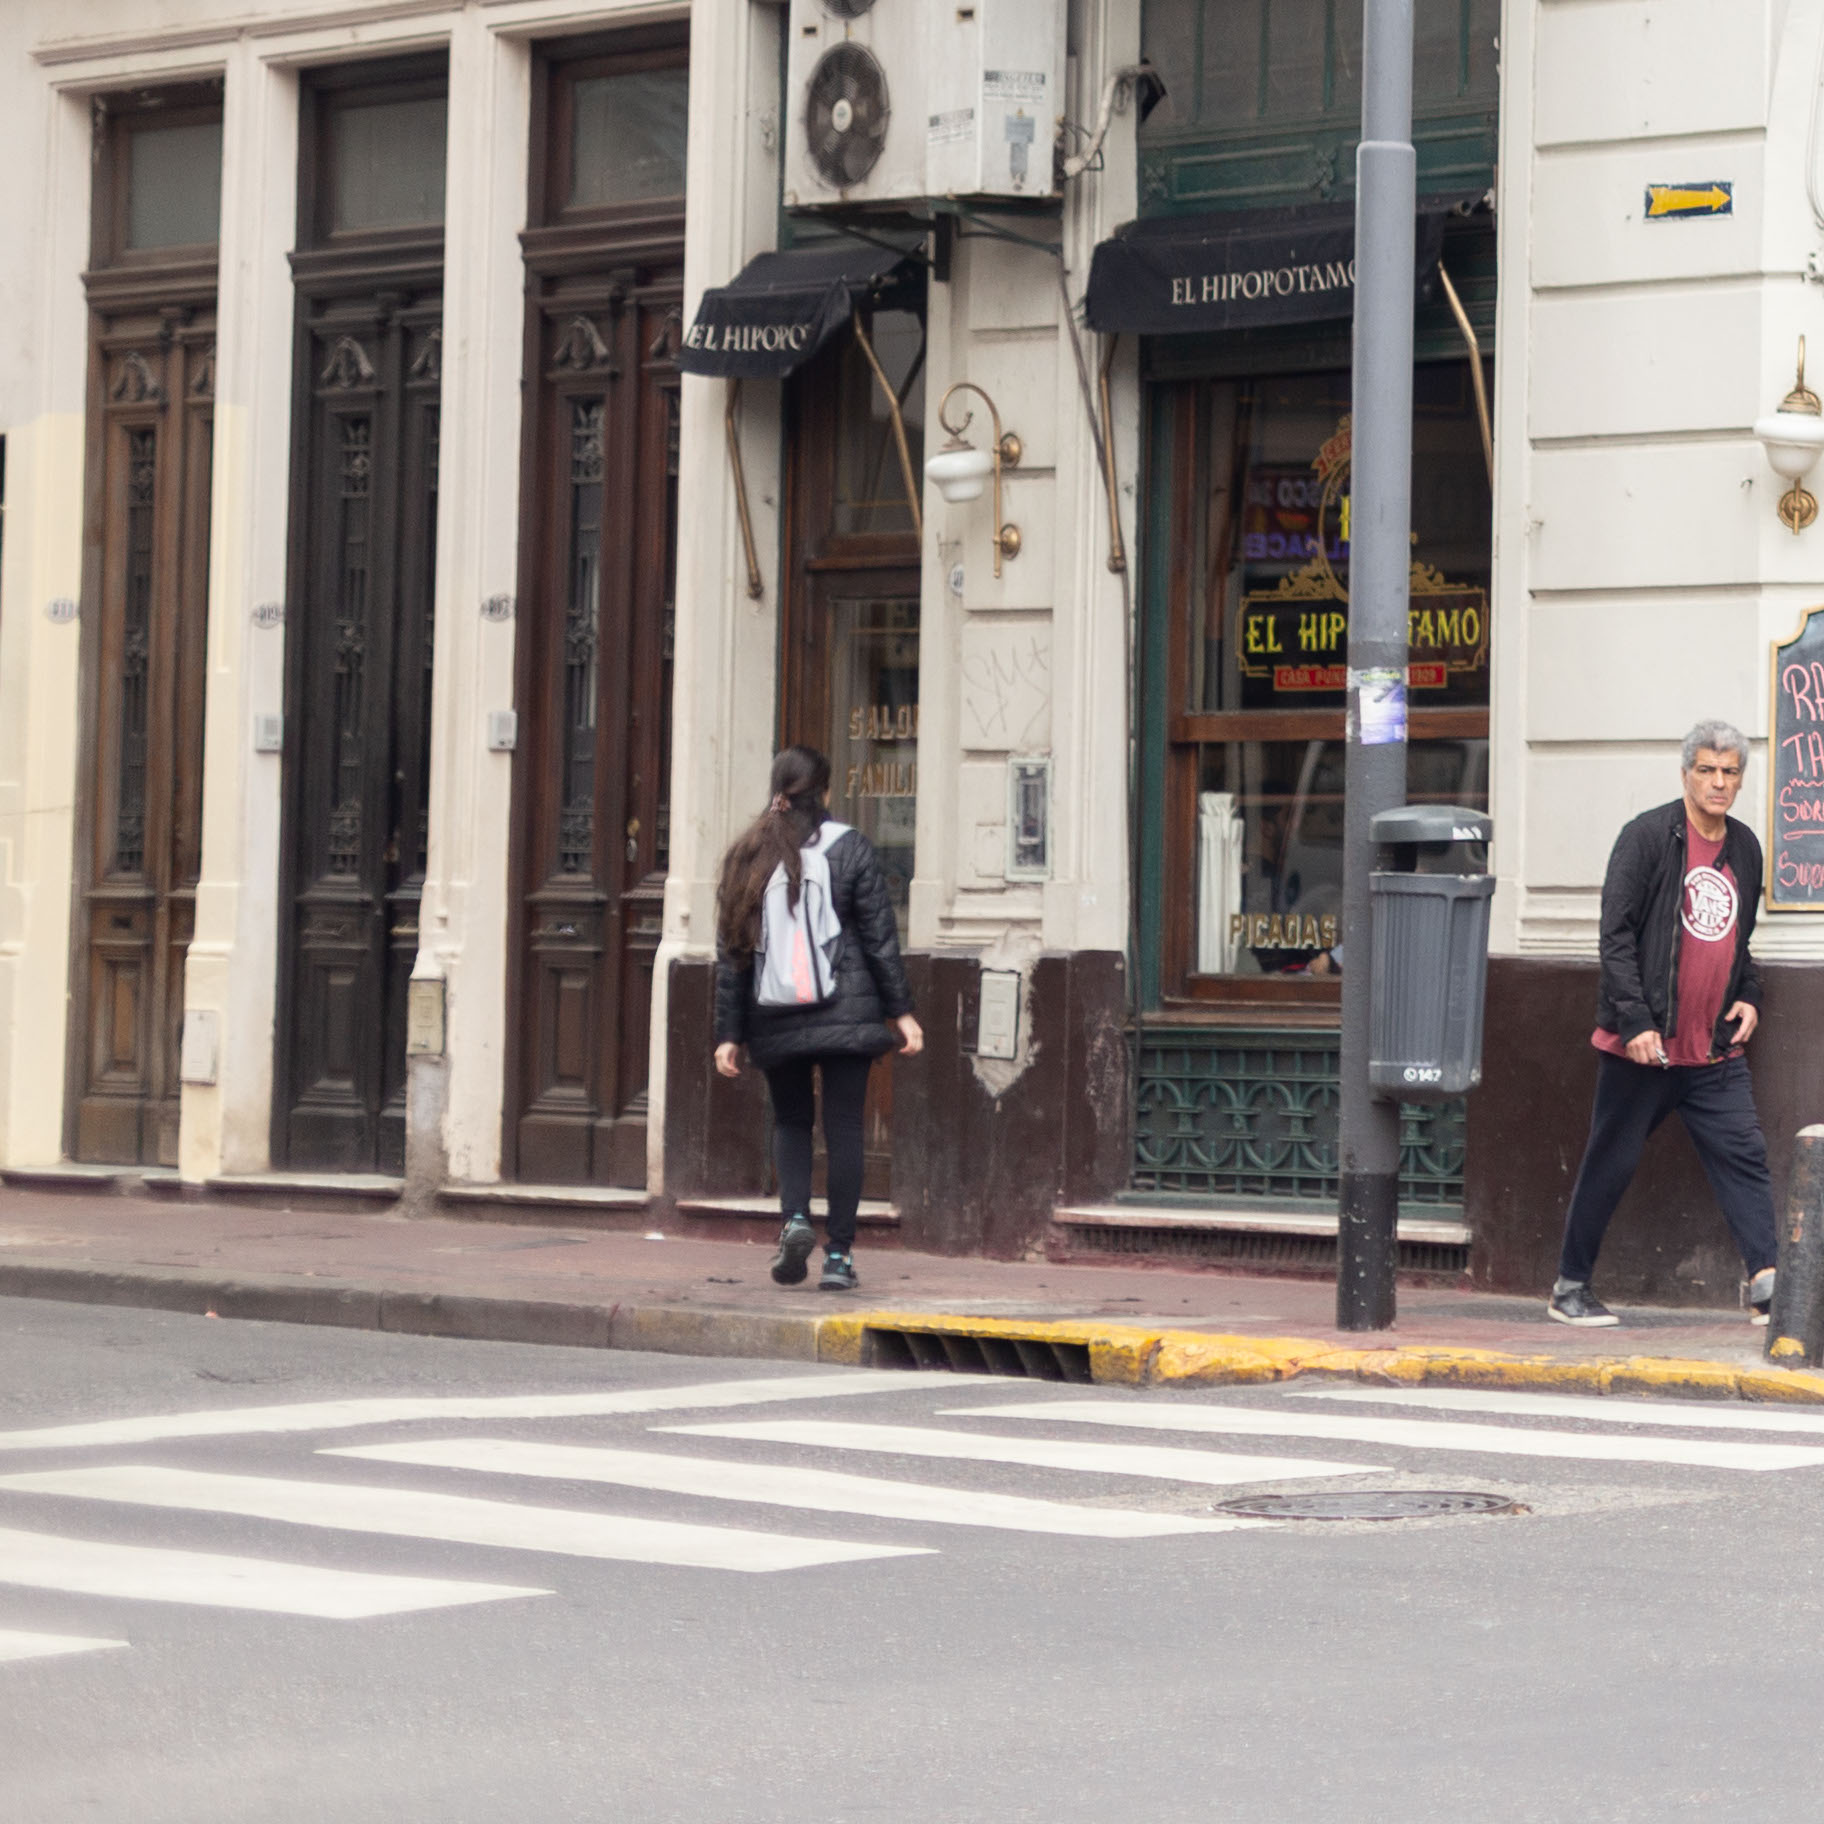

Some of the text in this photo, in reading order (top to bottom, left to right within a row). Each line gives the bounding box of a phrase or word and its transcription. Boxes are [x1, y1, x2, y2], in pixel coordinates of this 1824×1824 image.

[1172, 278, 1196, 305] EL
[1246, 616, 1282, 653] EL
[1688, 887, 1731, 918] VANS
[1229, 913, 1337, 949] PICADAS
[1418, 1068, 1442, 1083] 147
